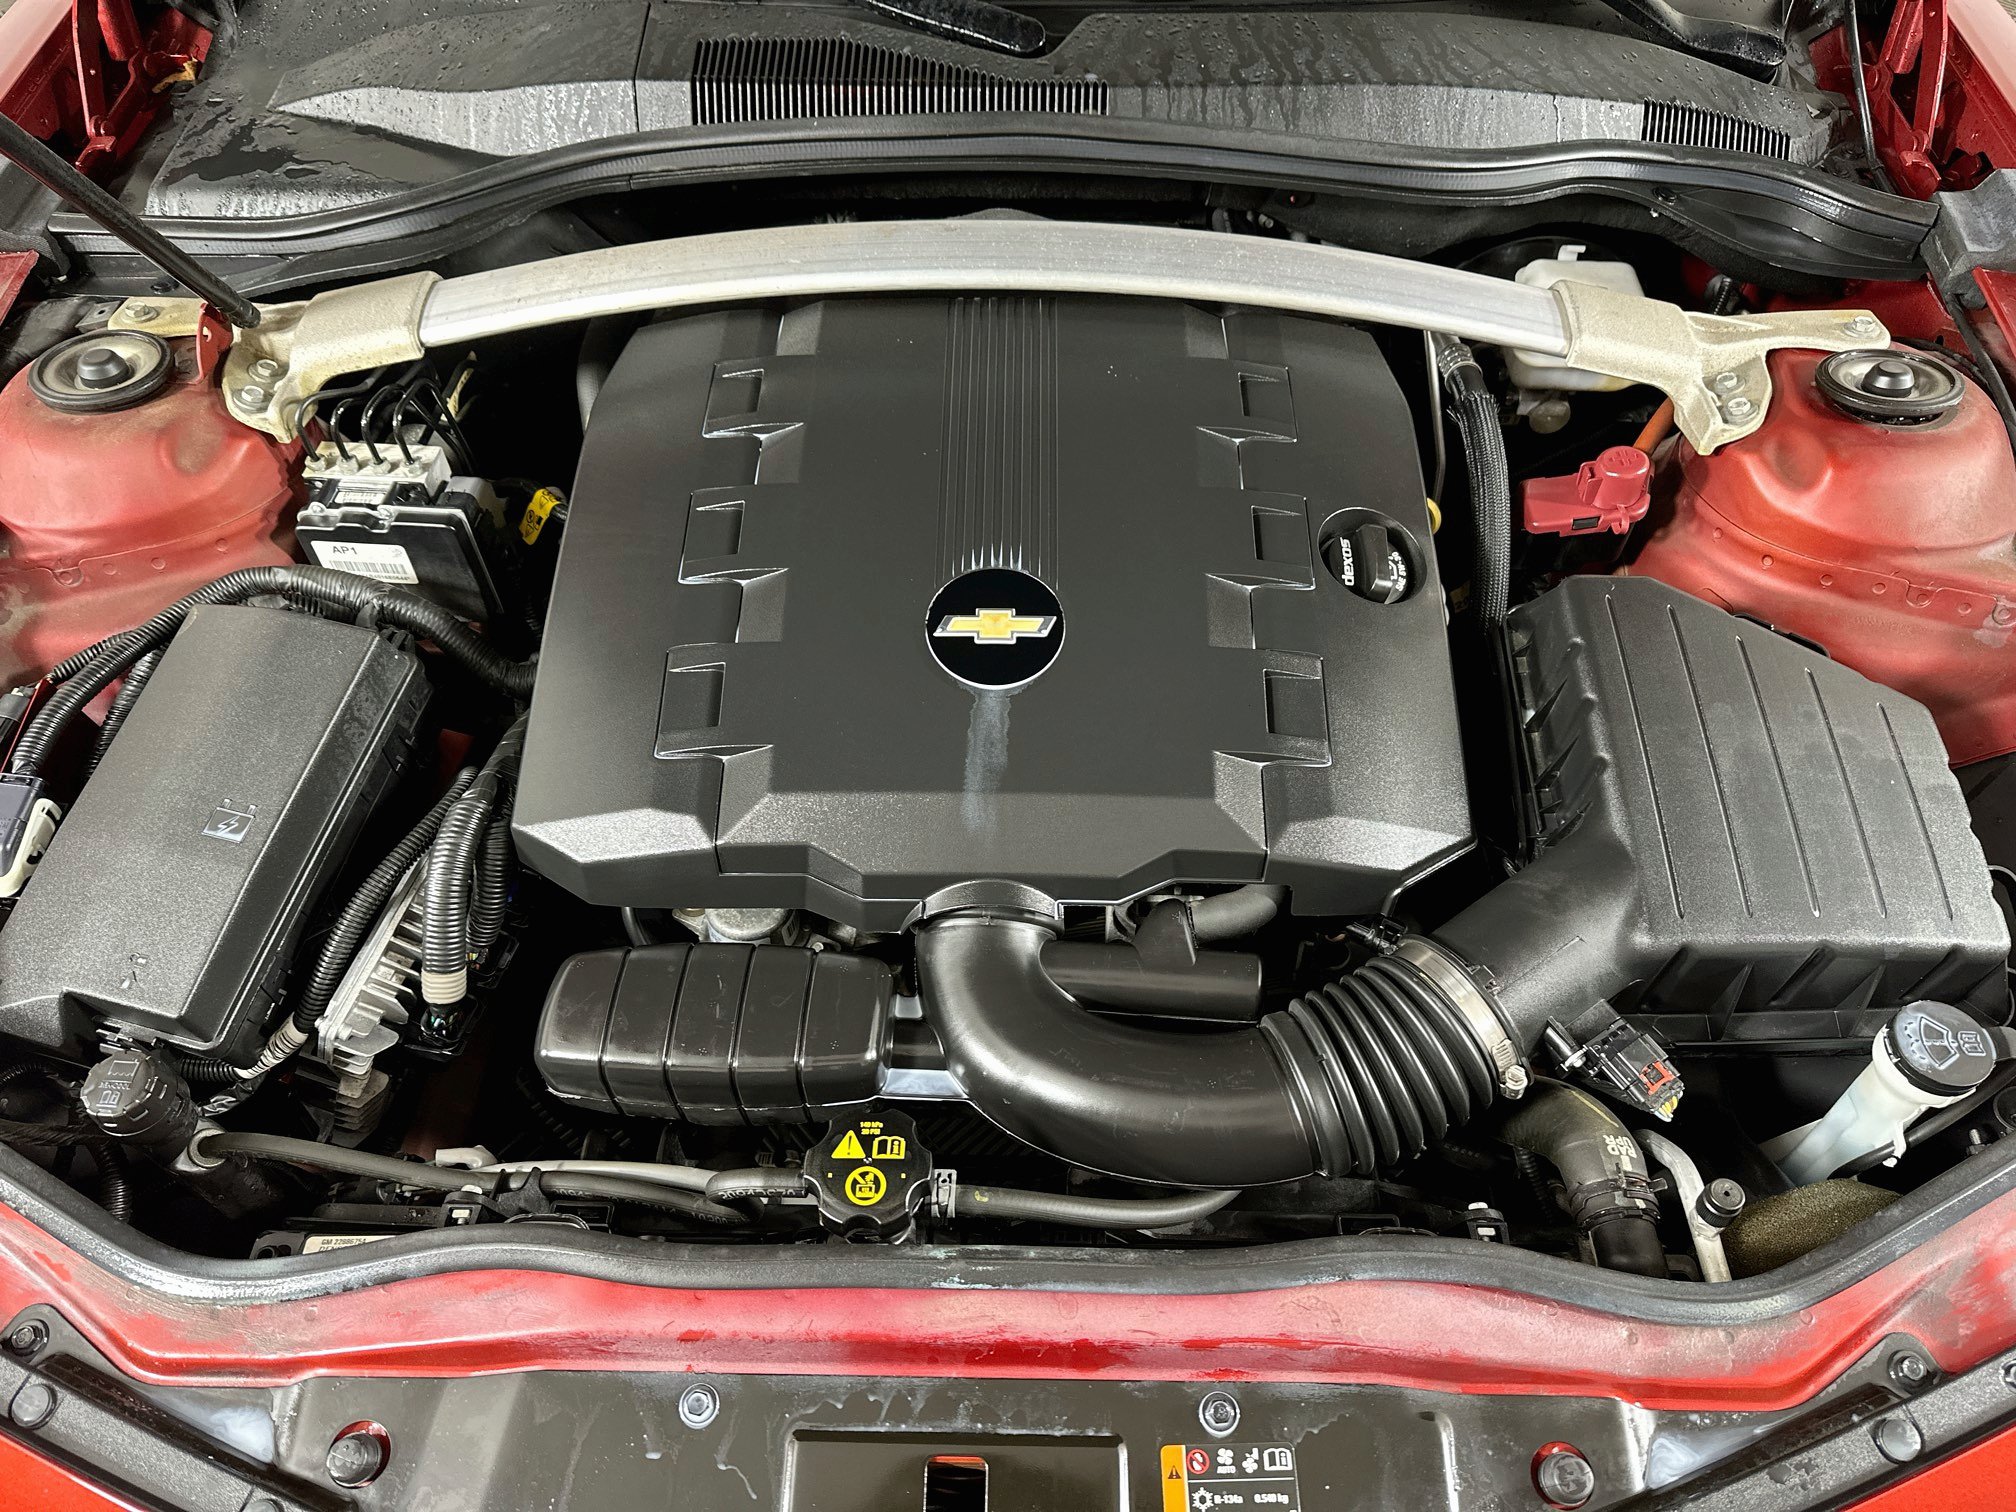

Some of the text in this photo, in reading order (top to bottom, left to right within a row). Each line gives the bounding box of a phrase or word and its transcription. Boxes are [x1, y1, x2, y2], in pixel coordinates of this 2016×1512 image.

[333, 545, 358, 555] AP1
[1340, 536, 1355, 587] dexos
[1391, 551, 1407, 592] SAE 5W-30
[1602, 1134, 1635, 1151] UPR
[1606, 1143, 1637, 1159] RAD
[321, 1238, 333, 1246] GM
